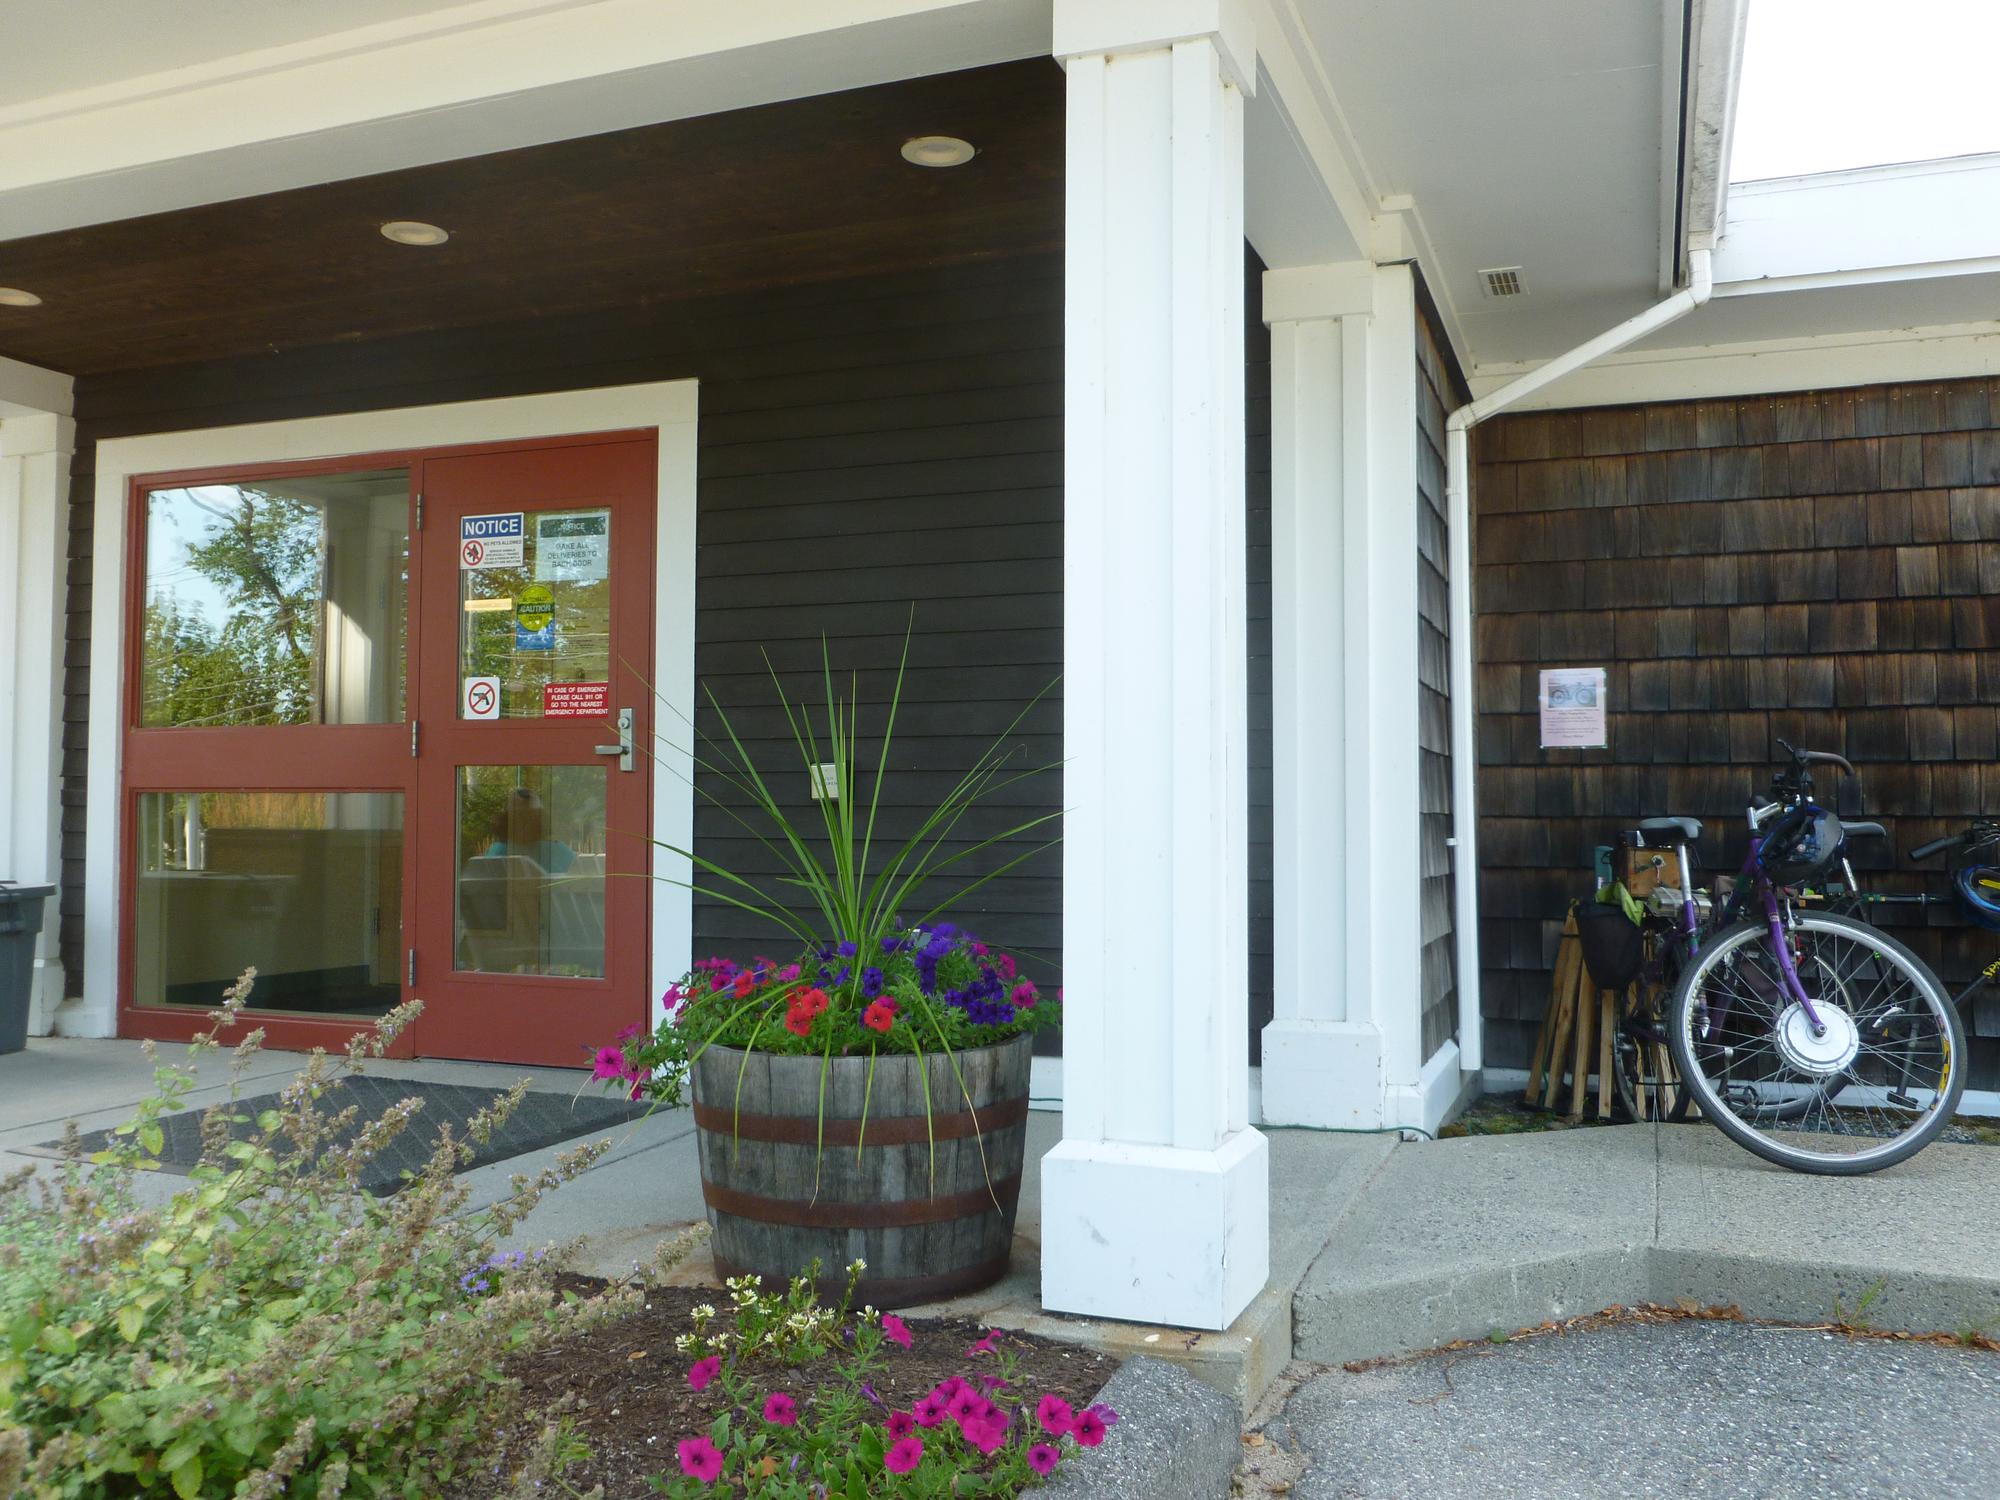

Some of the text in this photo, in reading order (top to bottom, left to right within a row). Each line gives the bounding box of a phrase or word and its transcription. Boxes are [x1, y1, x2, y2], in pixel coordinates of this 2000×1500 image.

[465, 519, 519, 535] NOTICE
[547, 551, 586, 559] DELIVERIES
[520, 603, 551, 612] CAUTION
